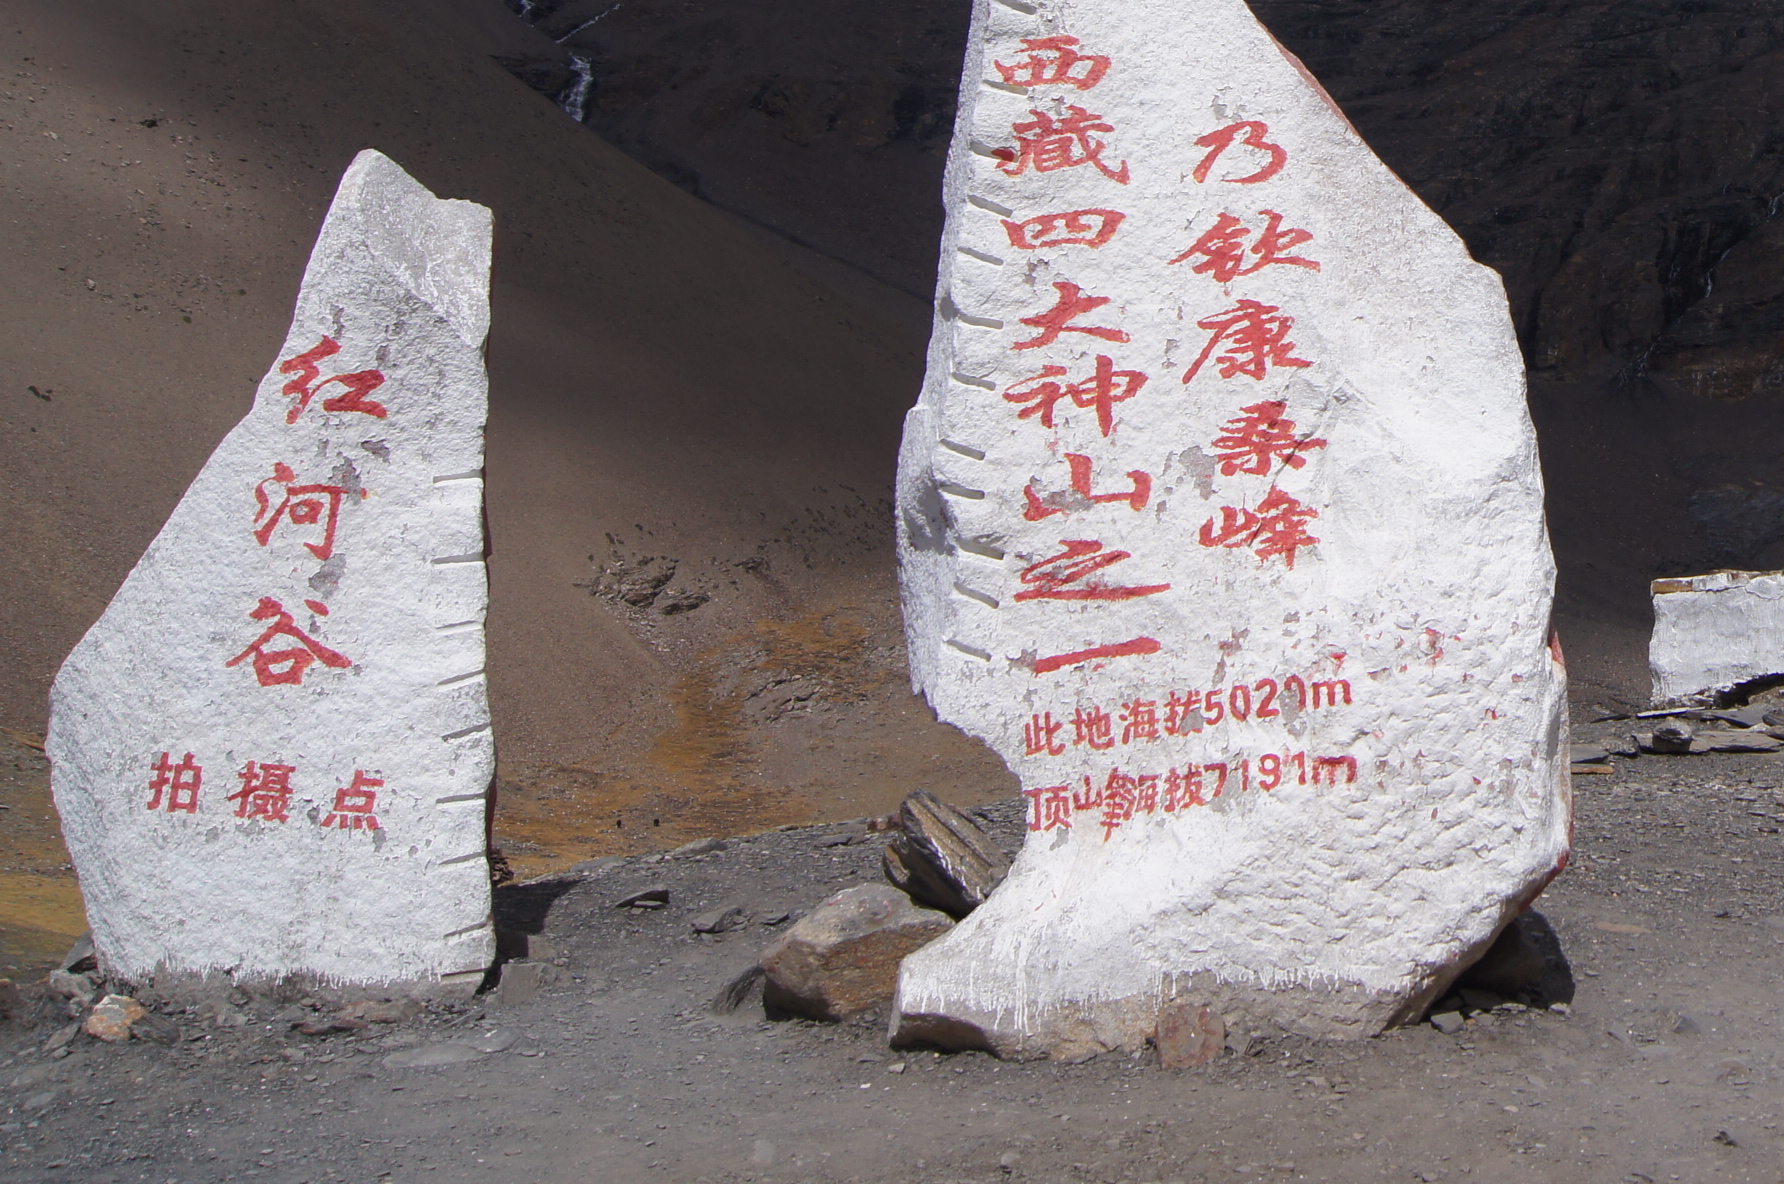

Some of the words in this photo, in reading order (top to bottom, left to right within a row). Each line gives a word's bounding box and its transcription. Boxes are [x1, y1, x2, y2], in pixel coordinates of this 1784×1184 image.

[226, 335, 389, 686] 红河谷
[993, 34, 1170, 675] 西藏四大神山之一
[147, 751, 386, 831] 拍摄点
